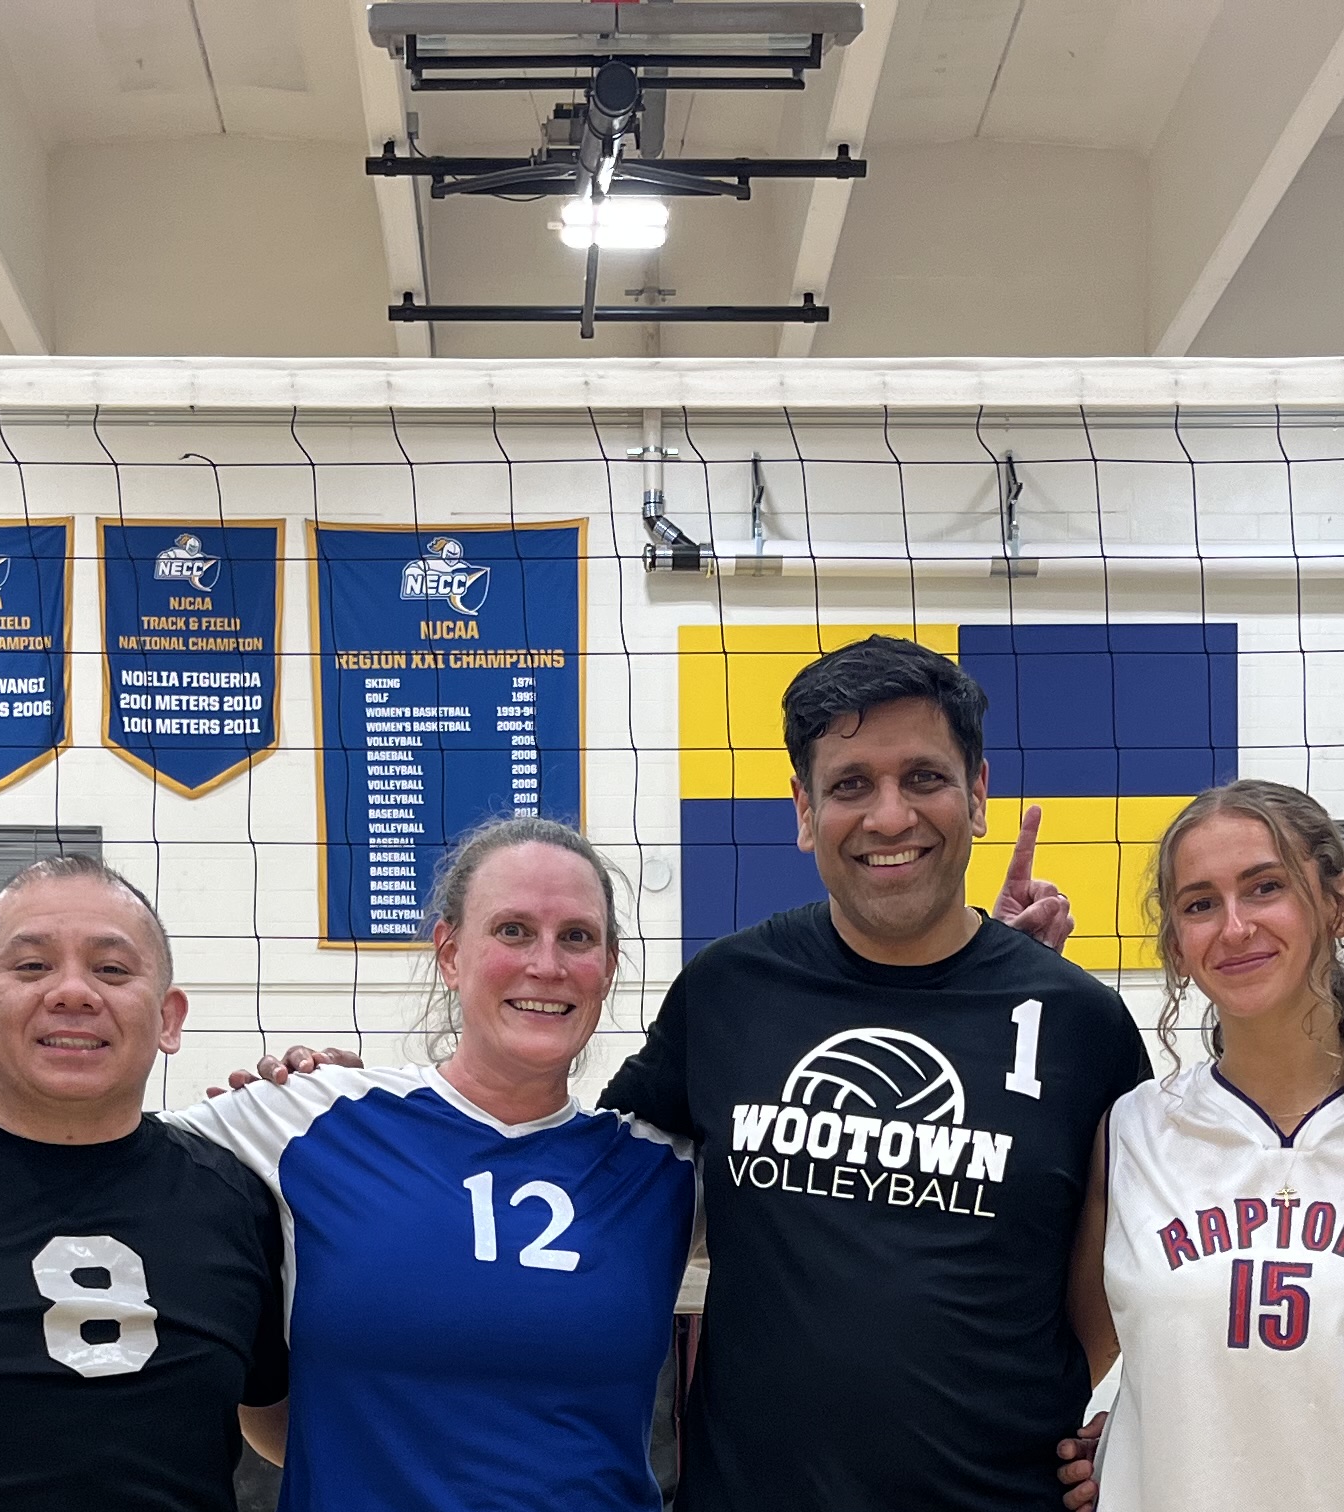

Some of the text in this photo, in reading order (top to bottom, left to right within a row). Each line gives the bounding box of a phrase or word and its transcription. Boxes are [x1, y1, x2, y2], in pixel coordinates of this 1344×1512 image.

[159, 561, 204, 576] NECC
[405, 574, 468, 595] NECC
[169, 597, 212, 611] NJCAA
[141, 617, 241, 631] TRACK & FIELD
[420, 620, 479, 640] NJCAA
[119, 636, 263, 651] NATIONAL CHAMPION
[335, 649, 565, 669] REGION XXI CHAMPIONS
[121, 670, 261, 688] NOELIA FIGUEROA
[365, 678, 401, 689] SKIING
[120, 695, 262, 711] 200 METERS 2010
[365, 692, 389, 703] GOLF
[13, 701, 54, 717] 2006
[366, 707, 411, 718] WOMEN'S
[412, 706, 471, 717] BASKETBALL
[122, 717, 261, 734] 100 METERS 2011
[366, 721, 411, 732] WOMEN'S
[413, 721, 471, 732] BASKETBALL
[367, 736, 423, 747] VOLLEYBALL
[367, 751, 414, 761] BASEBALL
[367, 765, 424, 776] VOLLEYBALL
[368, 780, 424, 790] VOLLEYBALL
[368, 793, 538, 805] VOLLEYBALL 2010
[368, 809, 415, 819] BASEBALL
[369, 823, 425, 834] VOLLEYBALL
[369, 852, 416, 863] BASEBALL
[370, 866, 417, 877] BASEBALL
[370, 881, 417, 891] BASEBALL
[370, 895, 417, 905] BASEBALL
[370, 909, 425, 920] VOLLEYBALL
[371, 924, 417, 934] BASEBALL
[1005, 998, 1043, 1100] 1
[731, 1103, 1013, 1183] WOOTOWN
[727, 1154, 995, 1218] VOLLEYBALL
[463, 1170, 580, 1272] 12
[31, 1235, 159, 1378] 8
[1227, 1259, 1313, 1351] 15
